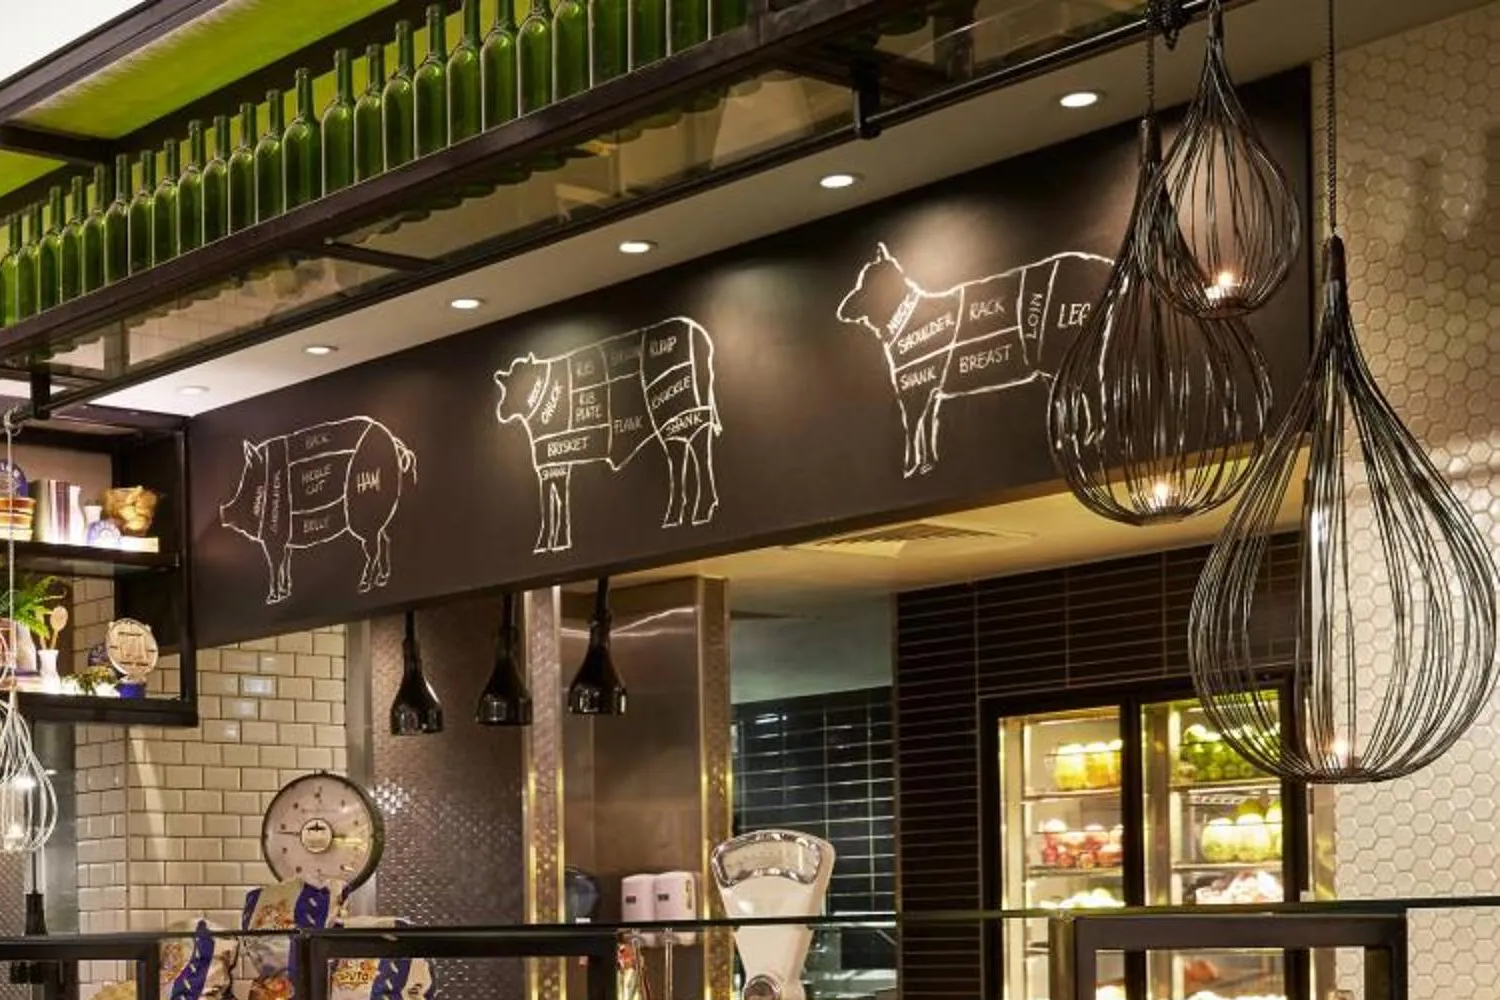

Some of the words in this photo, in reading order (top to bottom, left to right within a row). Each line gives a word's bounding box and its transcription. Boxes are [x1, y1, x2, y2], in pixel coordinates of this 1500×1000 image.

[969, 298, 1005, 320] RACK
[1026, 293, 1043, 339] LOIN
[898, 312, 955, 354] SHOULDER
[959, 344, 1012, 373] BREAST
[614, 417, 644, 434] FLANK
[357, 467, 381, 493] HAM
